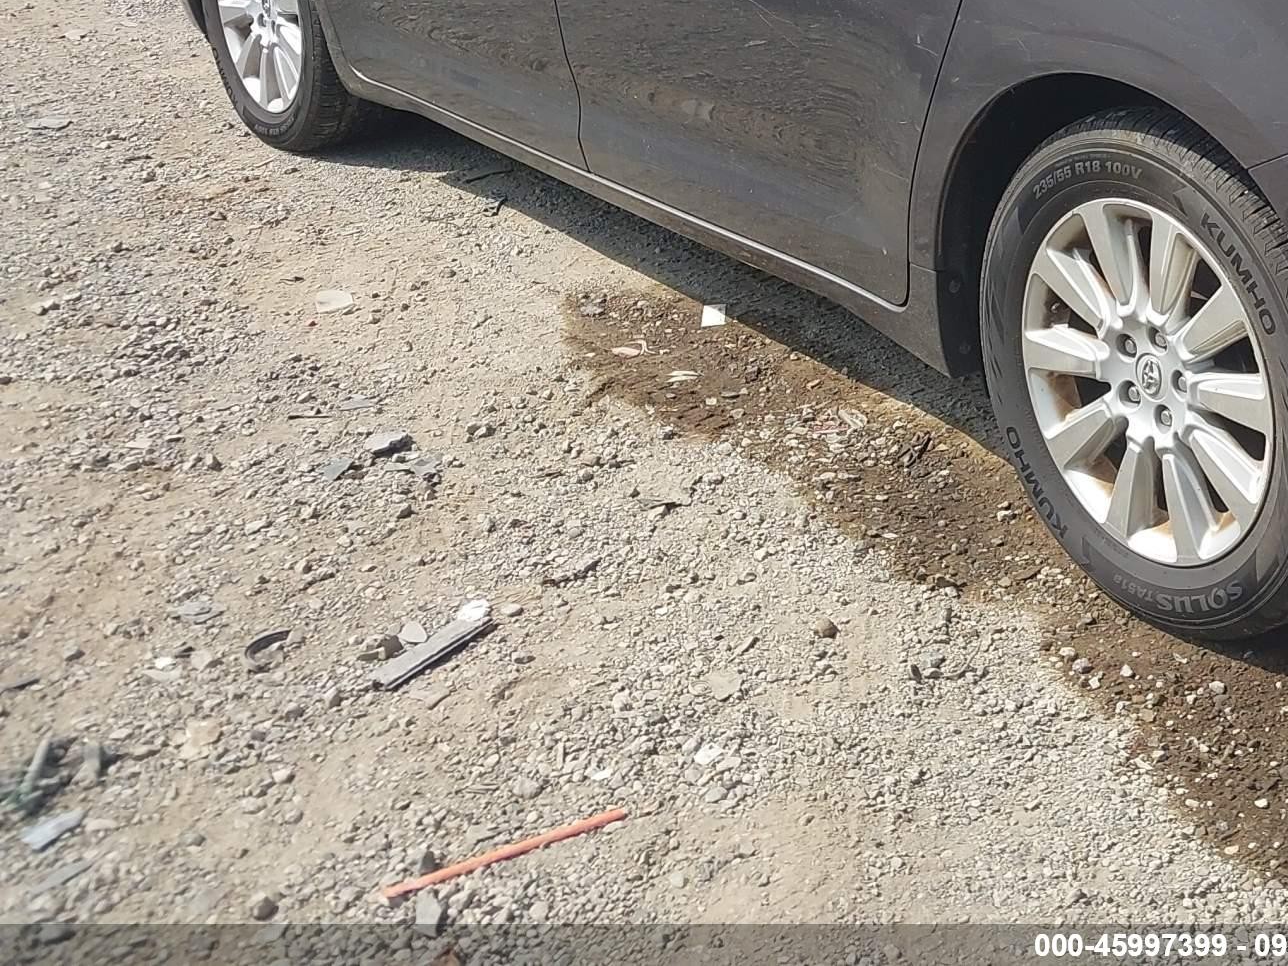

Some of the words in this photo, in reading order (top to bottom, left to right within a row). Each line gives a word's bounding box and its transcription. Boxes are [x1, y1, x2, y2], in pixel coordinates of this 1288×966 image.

[1032, 165, 1072, 200] 235/55
[1074, 161, 1102, 176] R18
[1105, 161, 1143, 180] 100V
[1200, 212, 1276, 336] KUMHO
[1006, 426, 1069, 539] KUMHO
[1155, 579, 1243, 614] SOLUS
